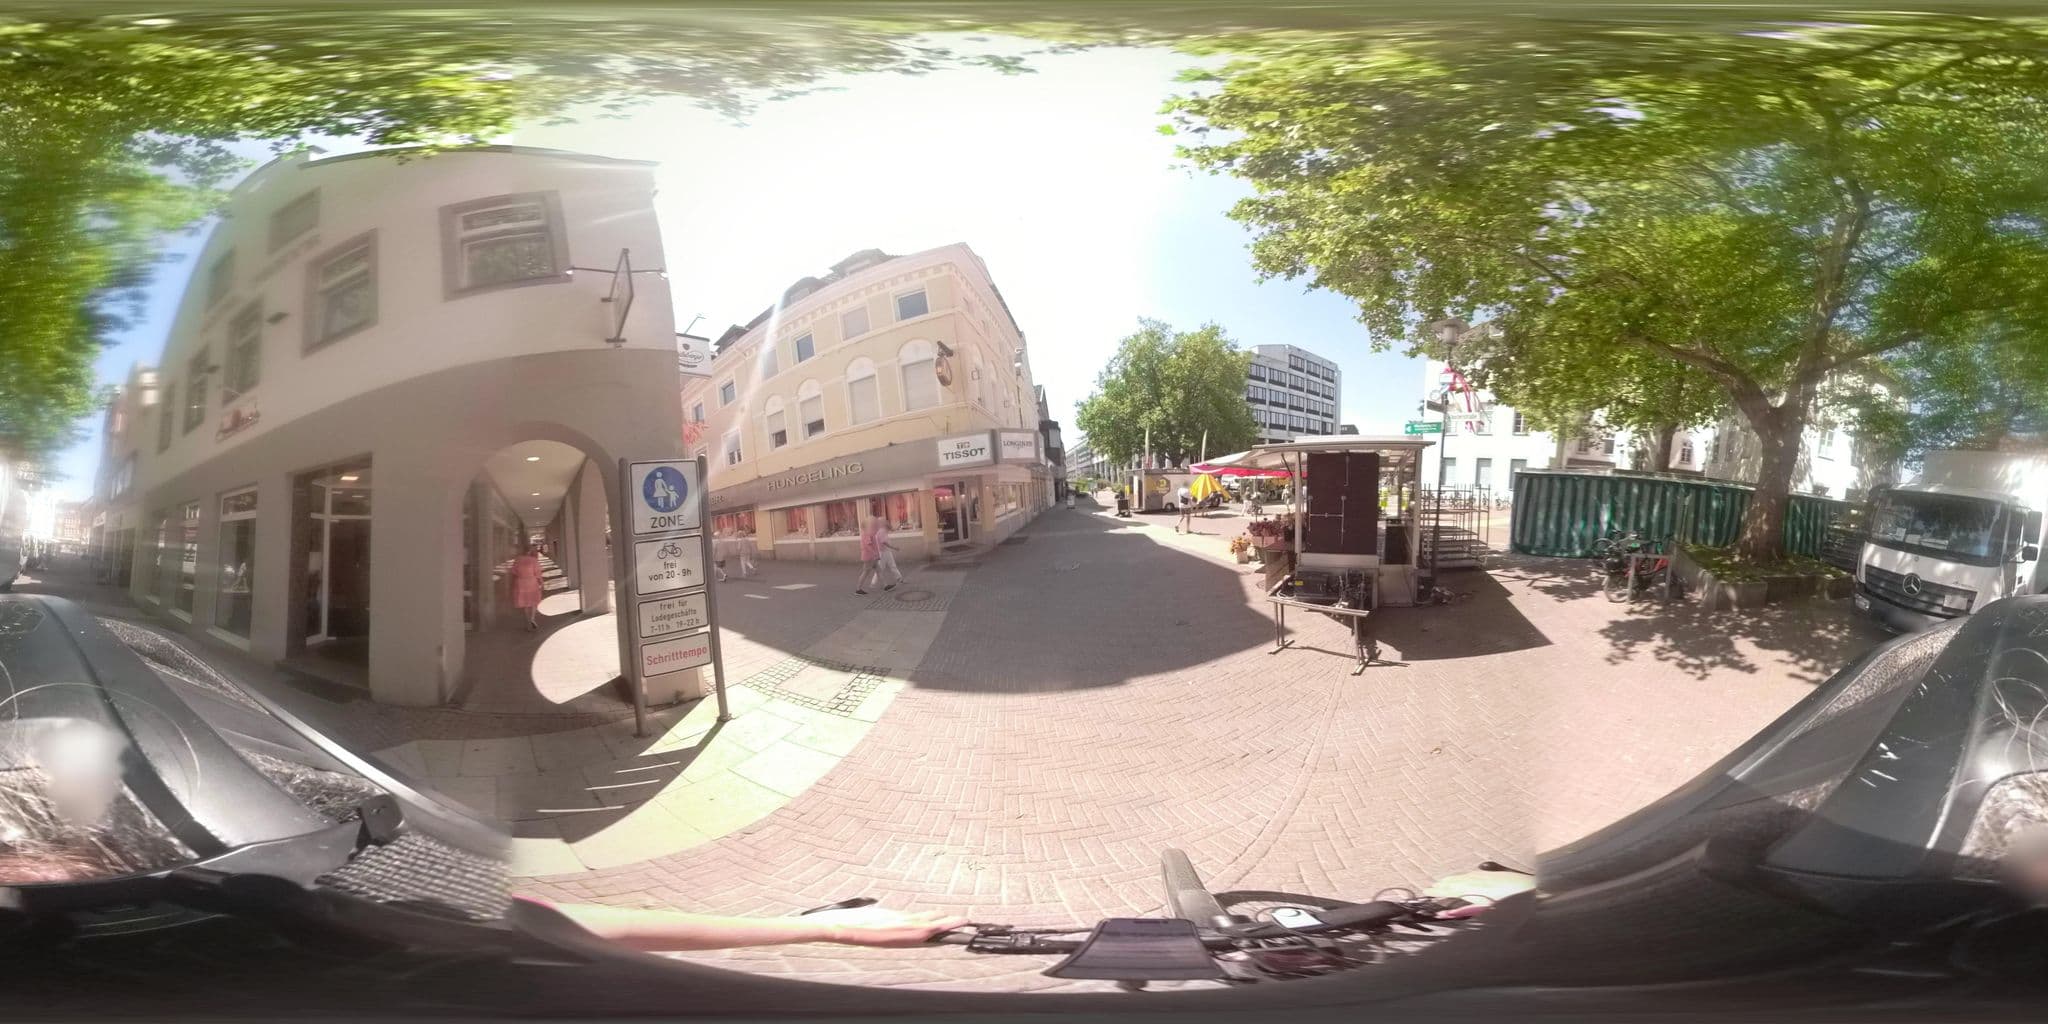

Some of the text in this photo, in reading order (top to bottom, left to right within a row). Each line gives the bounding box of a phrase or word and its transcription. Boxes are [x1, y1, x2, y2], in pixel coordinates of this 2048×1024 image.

[943, 447, 985, 461] TISSOT
[768, 462, 864, 492] HUNGELING
[650, 515, 685, 529] ZONE
[663, 561, 677, 570] frei
[649, 573, 664, 581] von
[666, 571, 675, 579] 20
[682, 568, 692, 577] 9h
[660, 601, 675, 610] frei
[646, 646, 708, 666] Schritttempo
